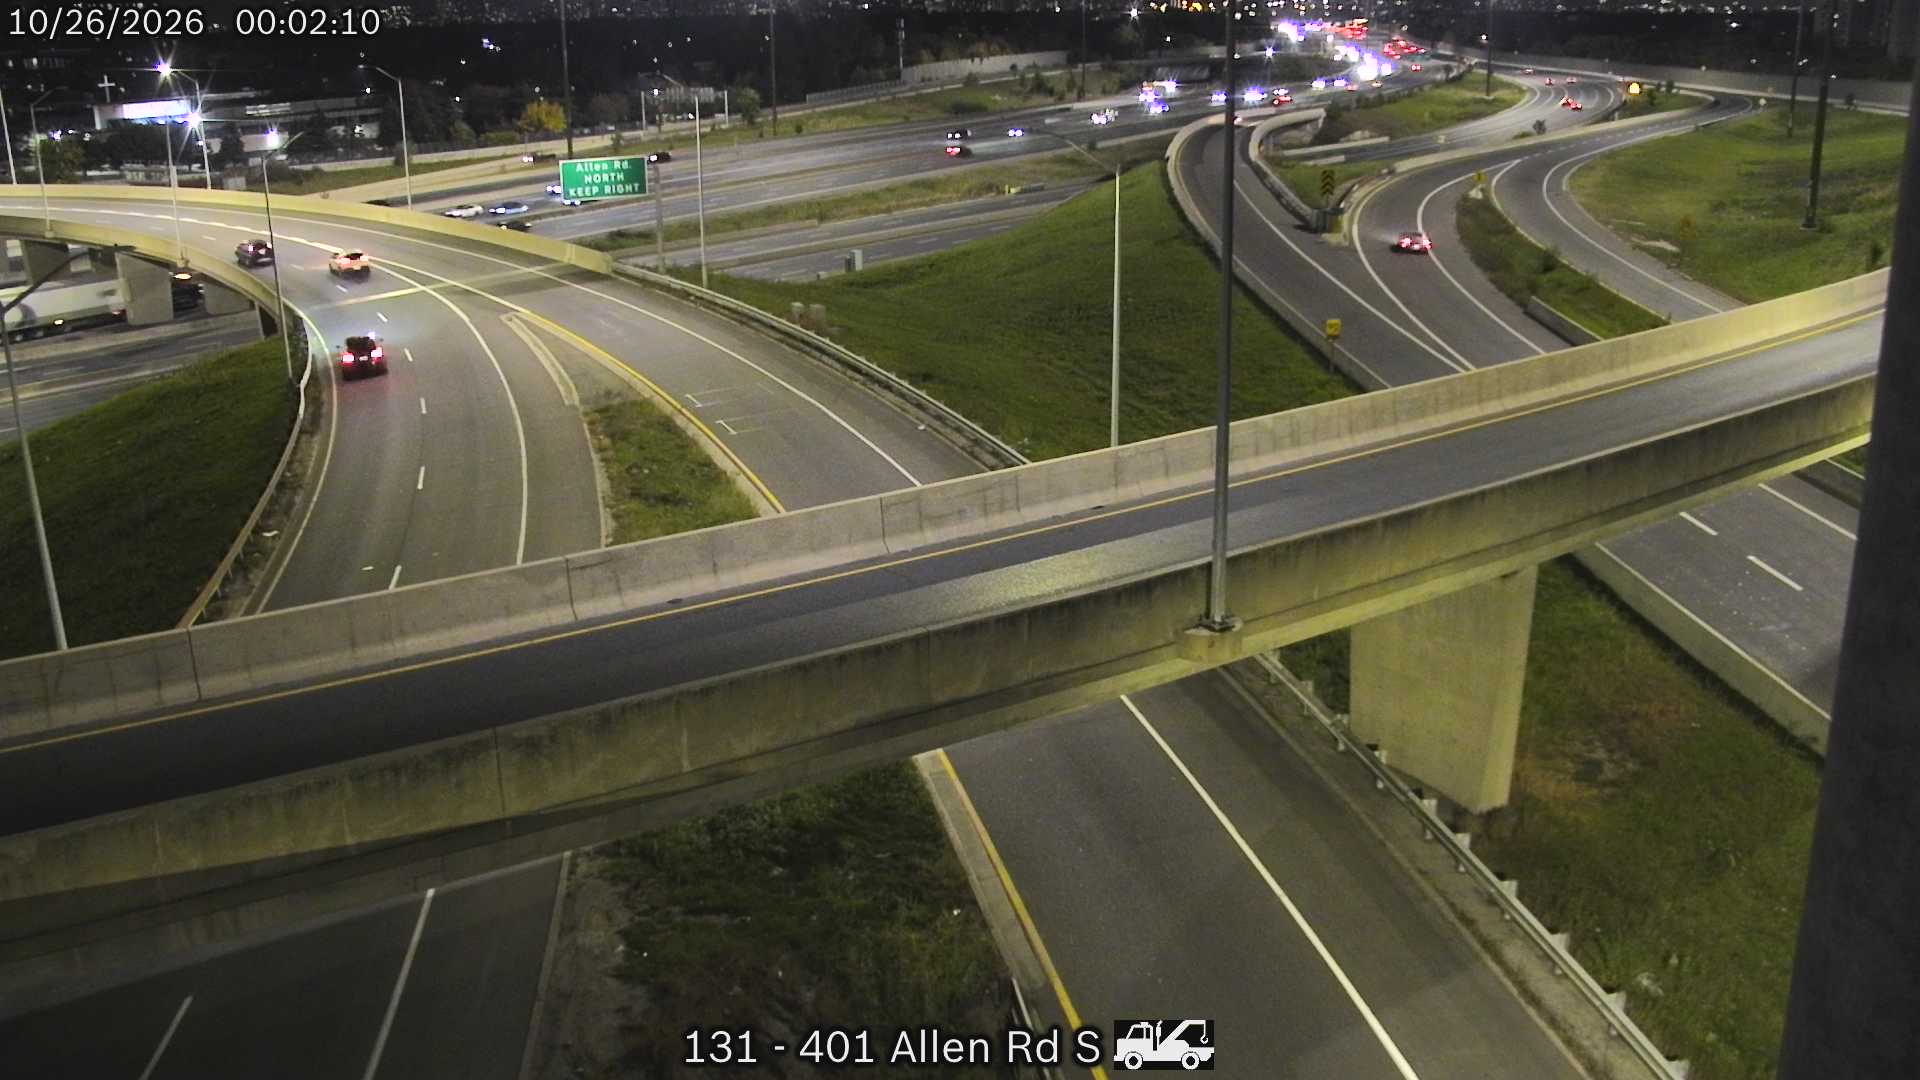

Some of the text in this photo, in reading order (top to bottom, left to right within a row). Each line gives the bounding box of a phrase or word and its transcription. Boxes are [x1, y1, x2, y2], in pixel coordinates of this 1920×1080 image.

[576, 162, 608, 172] Allen
[584, 172, 624, 184] NORTH
[569, 183, 640, 197] KEEP RIGHT
